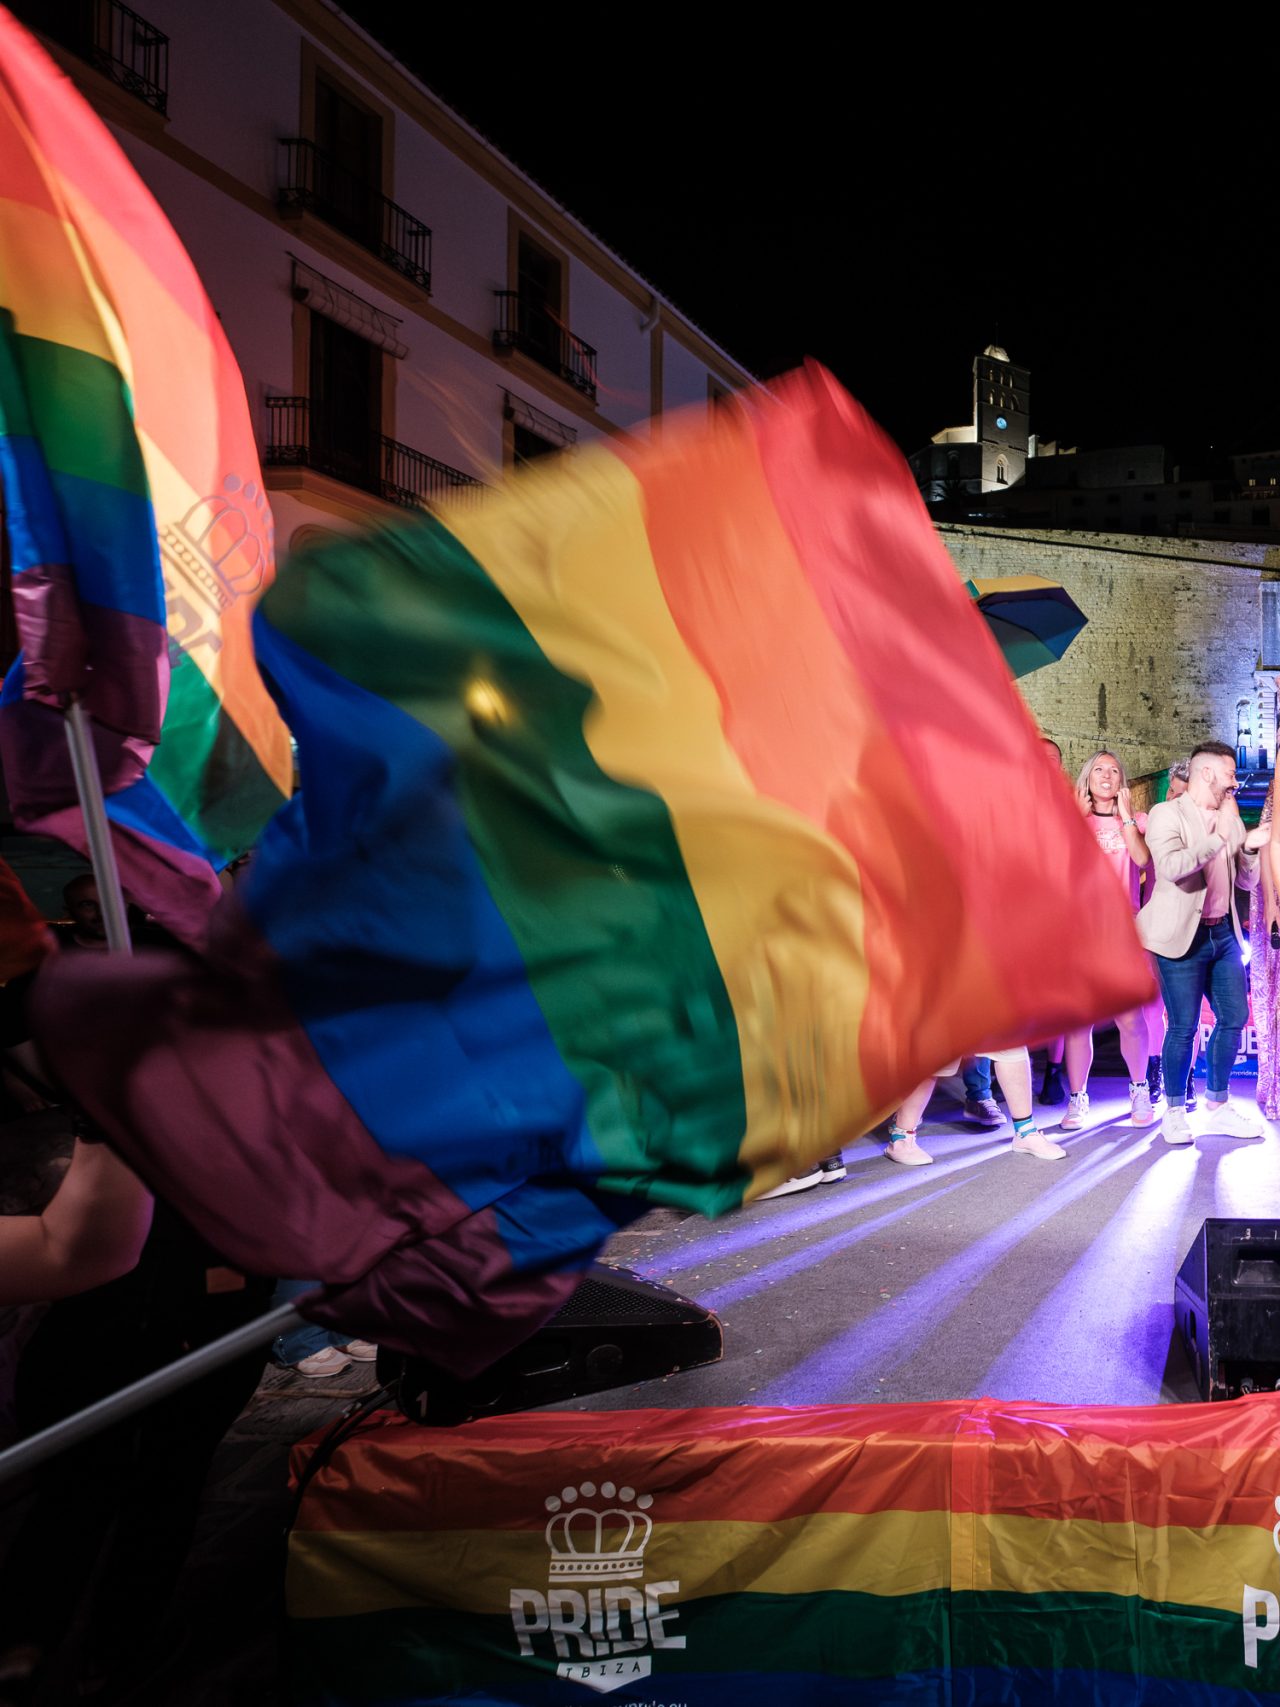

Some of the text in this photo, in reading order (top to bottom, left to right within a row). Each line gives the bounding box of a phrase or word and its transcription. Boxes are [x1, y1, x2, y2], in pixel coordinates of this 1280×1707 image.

[415, 1390, 428, 1418] 1
[510, 1580, 687, 1657] PRIDE
[563, 1661, 641, 1680] IBIZA
